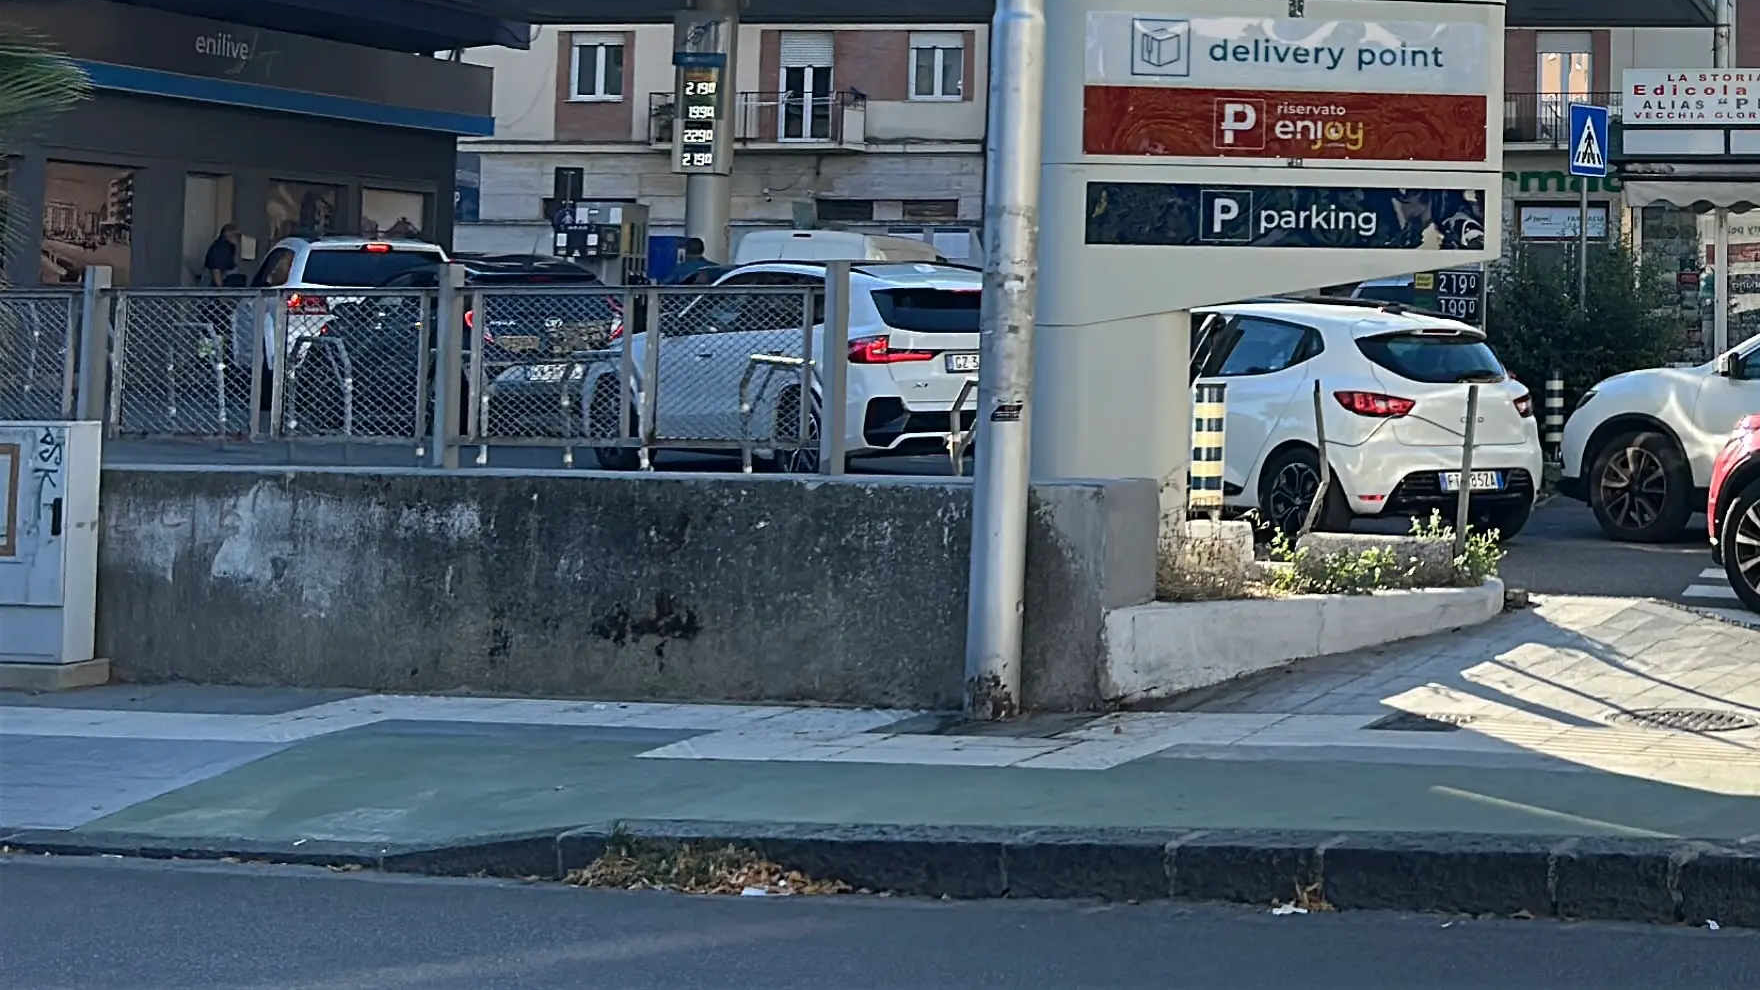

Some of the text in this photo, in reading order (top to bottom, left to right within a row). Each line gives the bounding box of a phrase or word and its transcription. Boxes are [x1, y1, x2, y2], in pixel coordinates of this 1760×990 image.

[196, 32, 249, 60] enilive
[1209, 38, 1444, 70] delivery point
[1667, 73, 1688, 82] LA
[1633, 84, 1748, 96] Edicola
[1276, 101, 1346, 117] riservato
[1642, 100, 1705, 110] ALIAS
[1275, 117, 1364, 150] enjoy
[1260, 204, 1378, 236] parking
